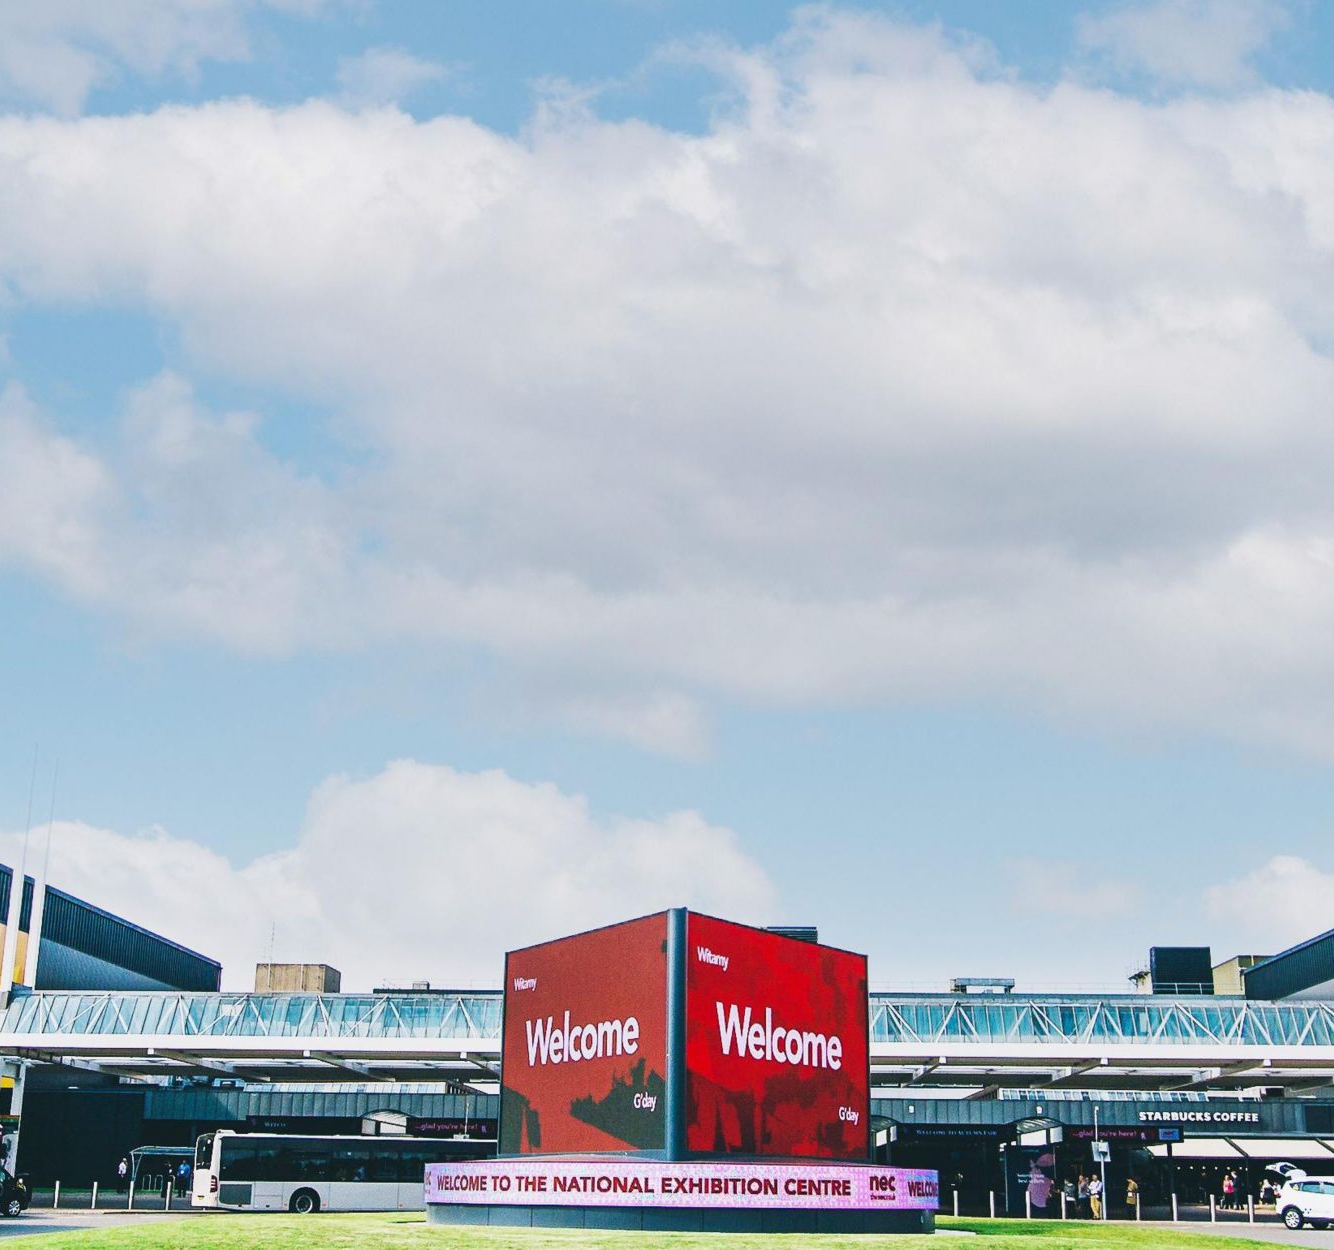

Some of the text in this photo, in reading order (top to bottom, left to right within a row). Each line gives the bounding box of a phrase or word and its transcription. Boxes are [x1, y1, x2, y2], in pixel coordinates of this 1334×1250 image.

[697, 946, 729, 972] Witamy
[514, 976, 537, 991] Witamy
[526, 1010, 640, 1067] Welcome
[716, 1001, 842, 1070] Welcome
[634, 1091, 657, 1111] G'day
[839, 1106, 859, 1126] G'day
[1139, 1111, 1259, 1122] STARBUCKS COFFEE
[437, 1175, 487, 1191] WELCOME
[492, 1175, 511, 1192] TO
[515, 1175, 547, 1192] THE
[553, 1176, 655, 1194] NATIONAL
[661, 1176, 778, 1196] EXHIBITION
[784, 1178, 852, 1196] CENTRE
[870, 1175, 896, 1191] nec
